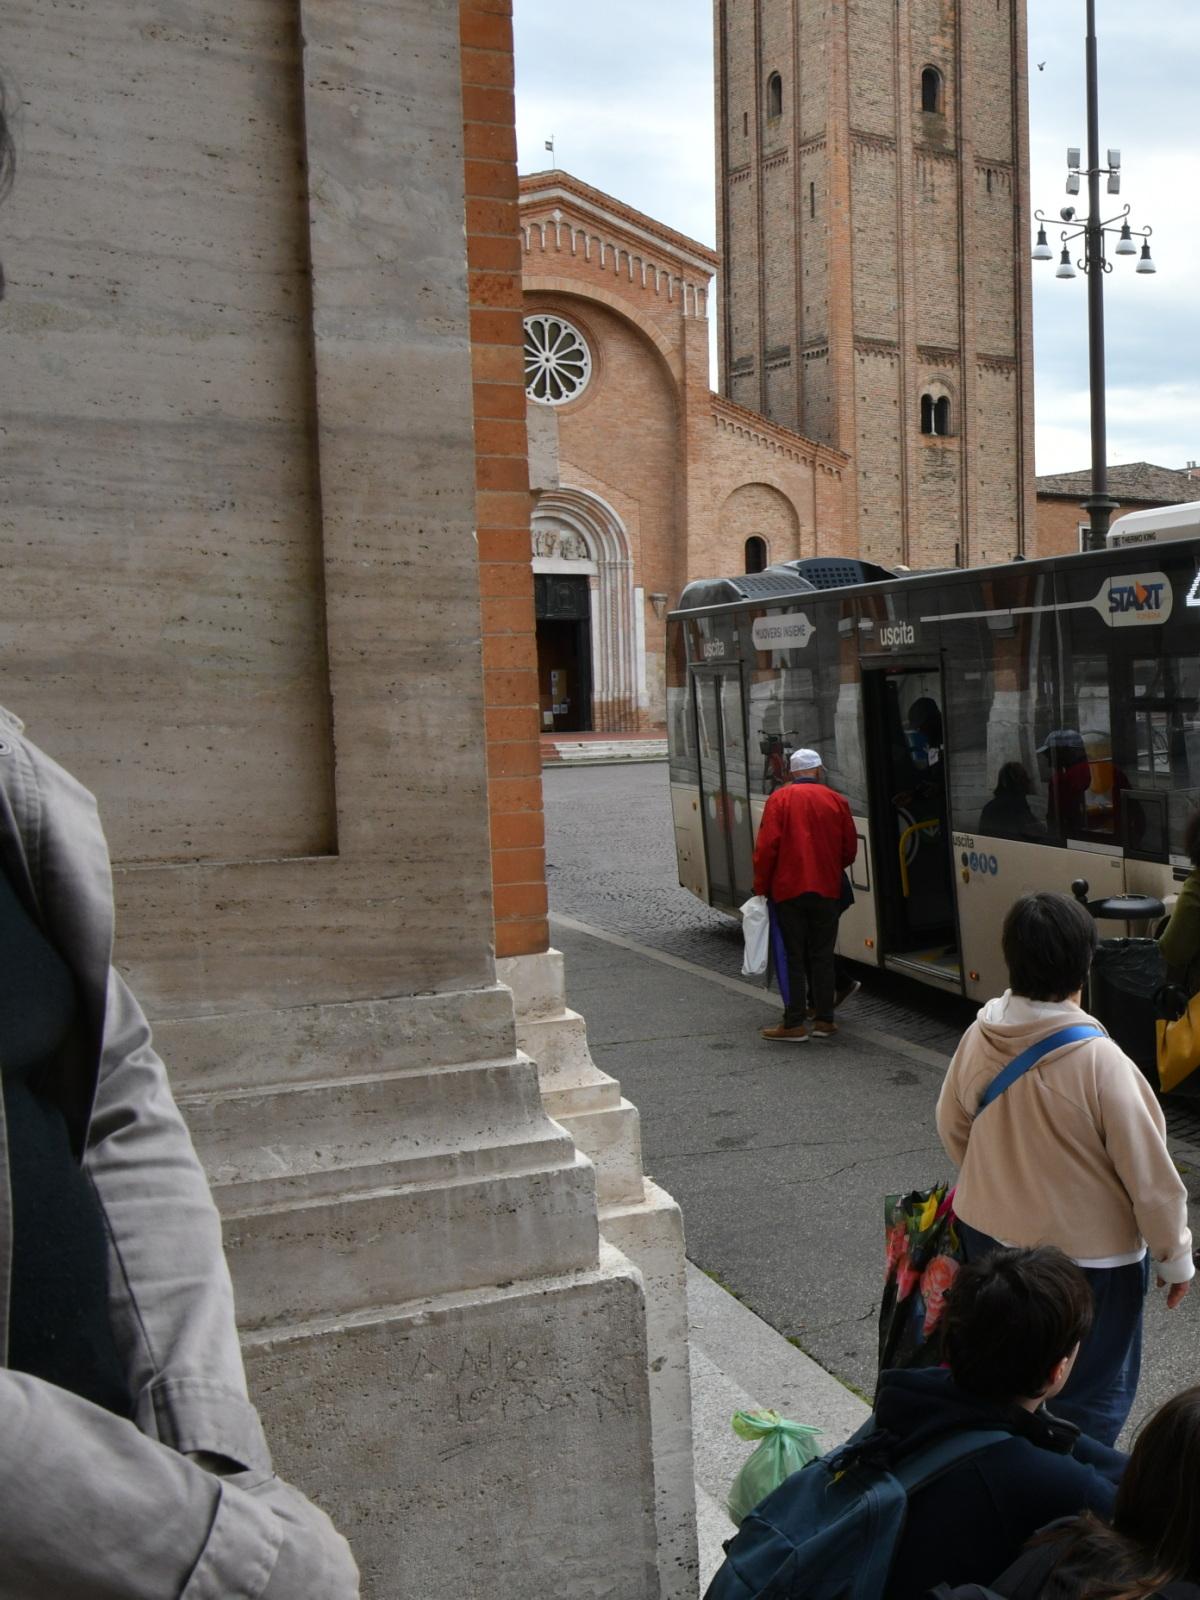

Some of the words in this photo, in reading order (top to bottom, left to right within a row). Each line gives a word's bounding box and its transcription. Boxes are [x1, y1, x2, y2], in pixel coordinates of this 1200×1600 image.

[1121, 533, 1143, 545] THERMO
[1143, 531, 1157, 542] KING
[1107, 582, 1164, 613] START
[880, 620, 915, 646] uscita
[703, 637, 725, 657] uscita
